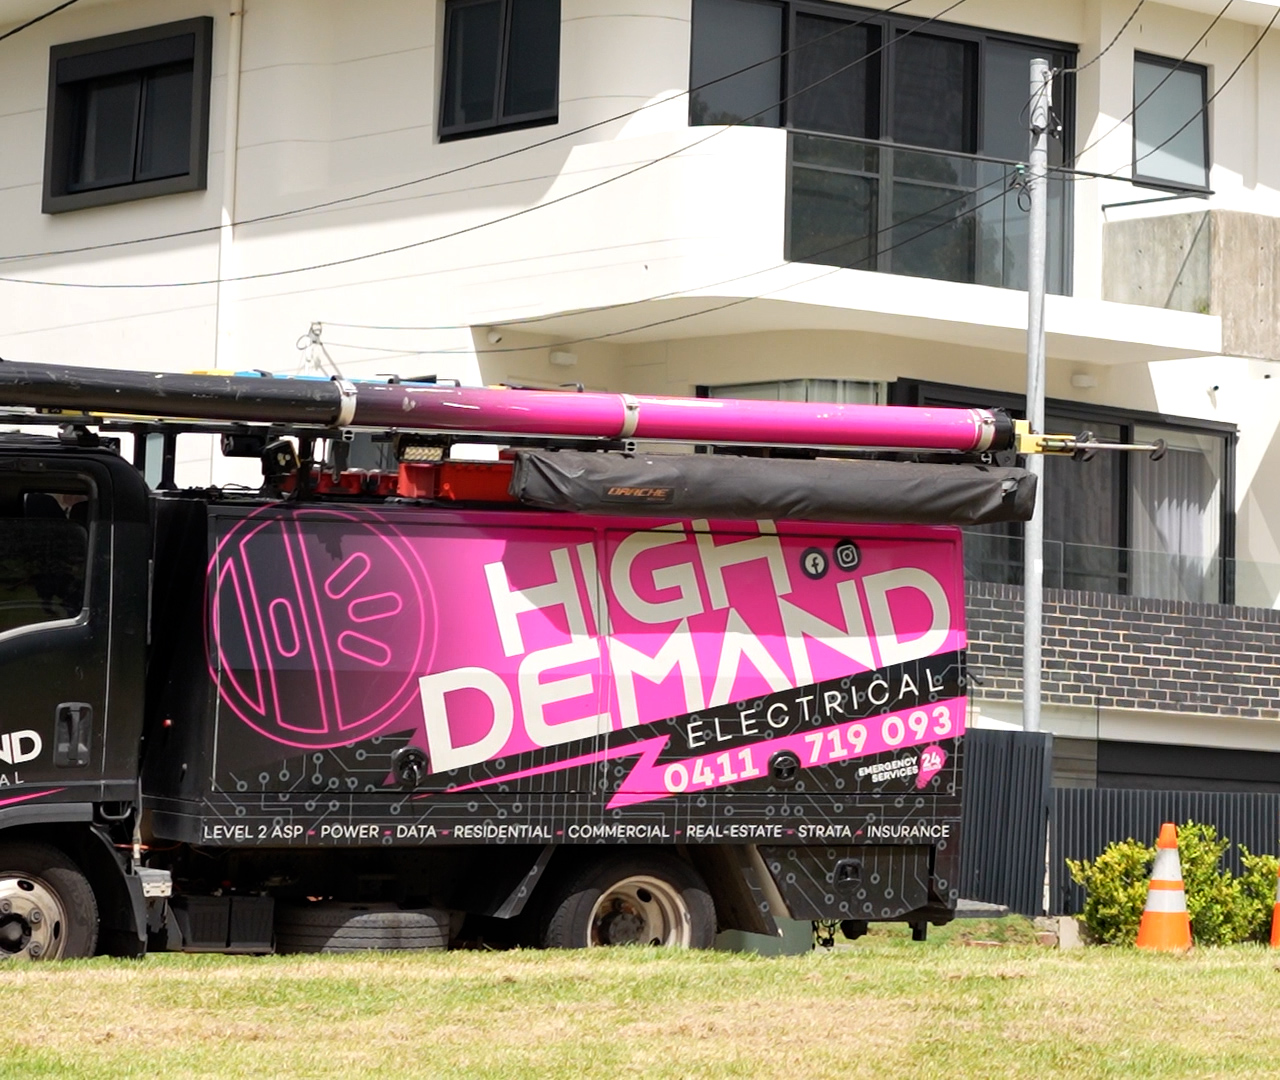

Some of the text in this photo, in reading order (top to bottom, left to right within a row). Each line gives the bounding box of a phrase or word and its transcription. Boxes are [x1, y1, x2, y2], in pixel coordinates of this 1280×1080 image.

[483, 519, 792, 658] HIGH
[418, 567, 951, 774] DEMAND
[687, 668, 944, 748] ELECTRICAL
[664, 706, 952, 793] 0411 719 093
[858, 756, 918, 777] EMERGENCY
[921, 751, 942, 769] 24
[871, 765, 919, 783] SERVICES
[203, 825, 304, 839] LEVEL 2 ASP
[320, 825, 380, 839] POWER
[396, 825, 438, 839] DATA
[453, 825, 553, 839] RESIDENTIAL
[567, 824, 670, 839] COMMERCIAL
[685, 824, 783, 839] REAL-ESTATE
[798, 824, 852, 839] STRATA
[867, 824, 951, 838] INSURANCE
